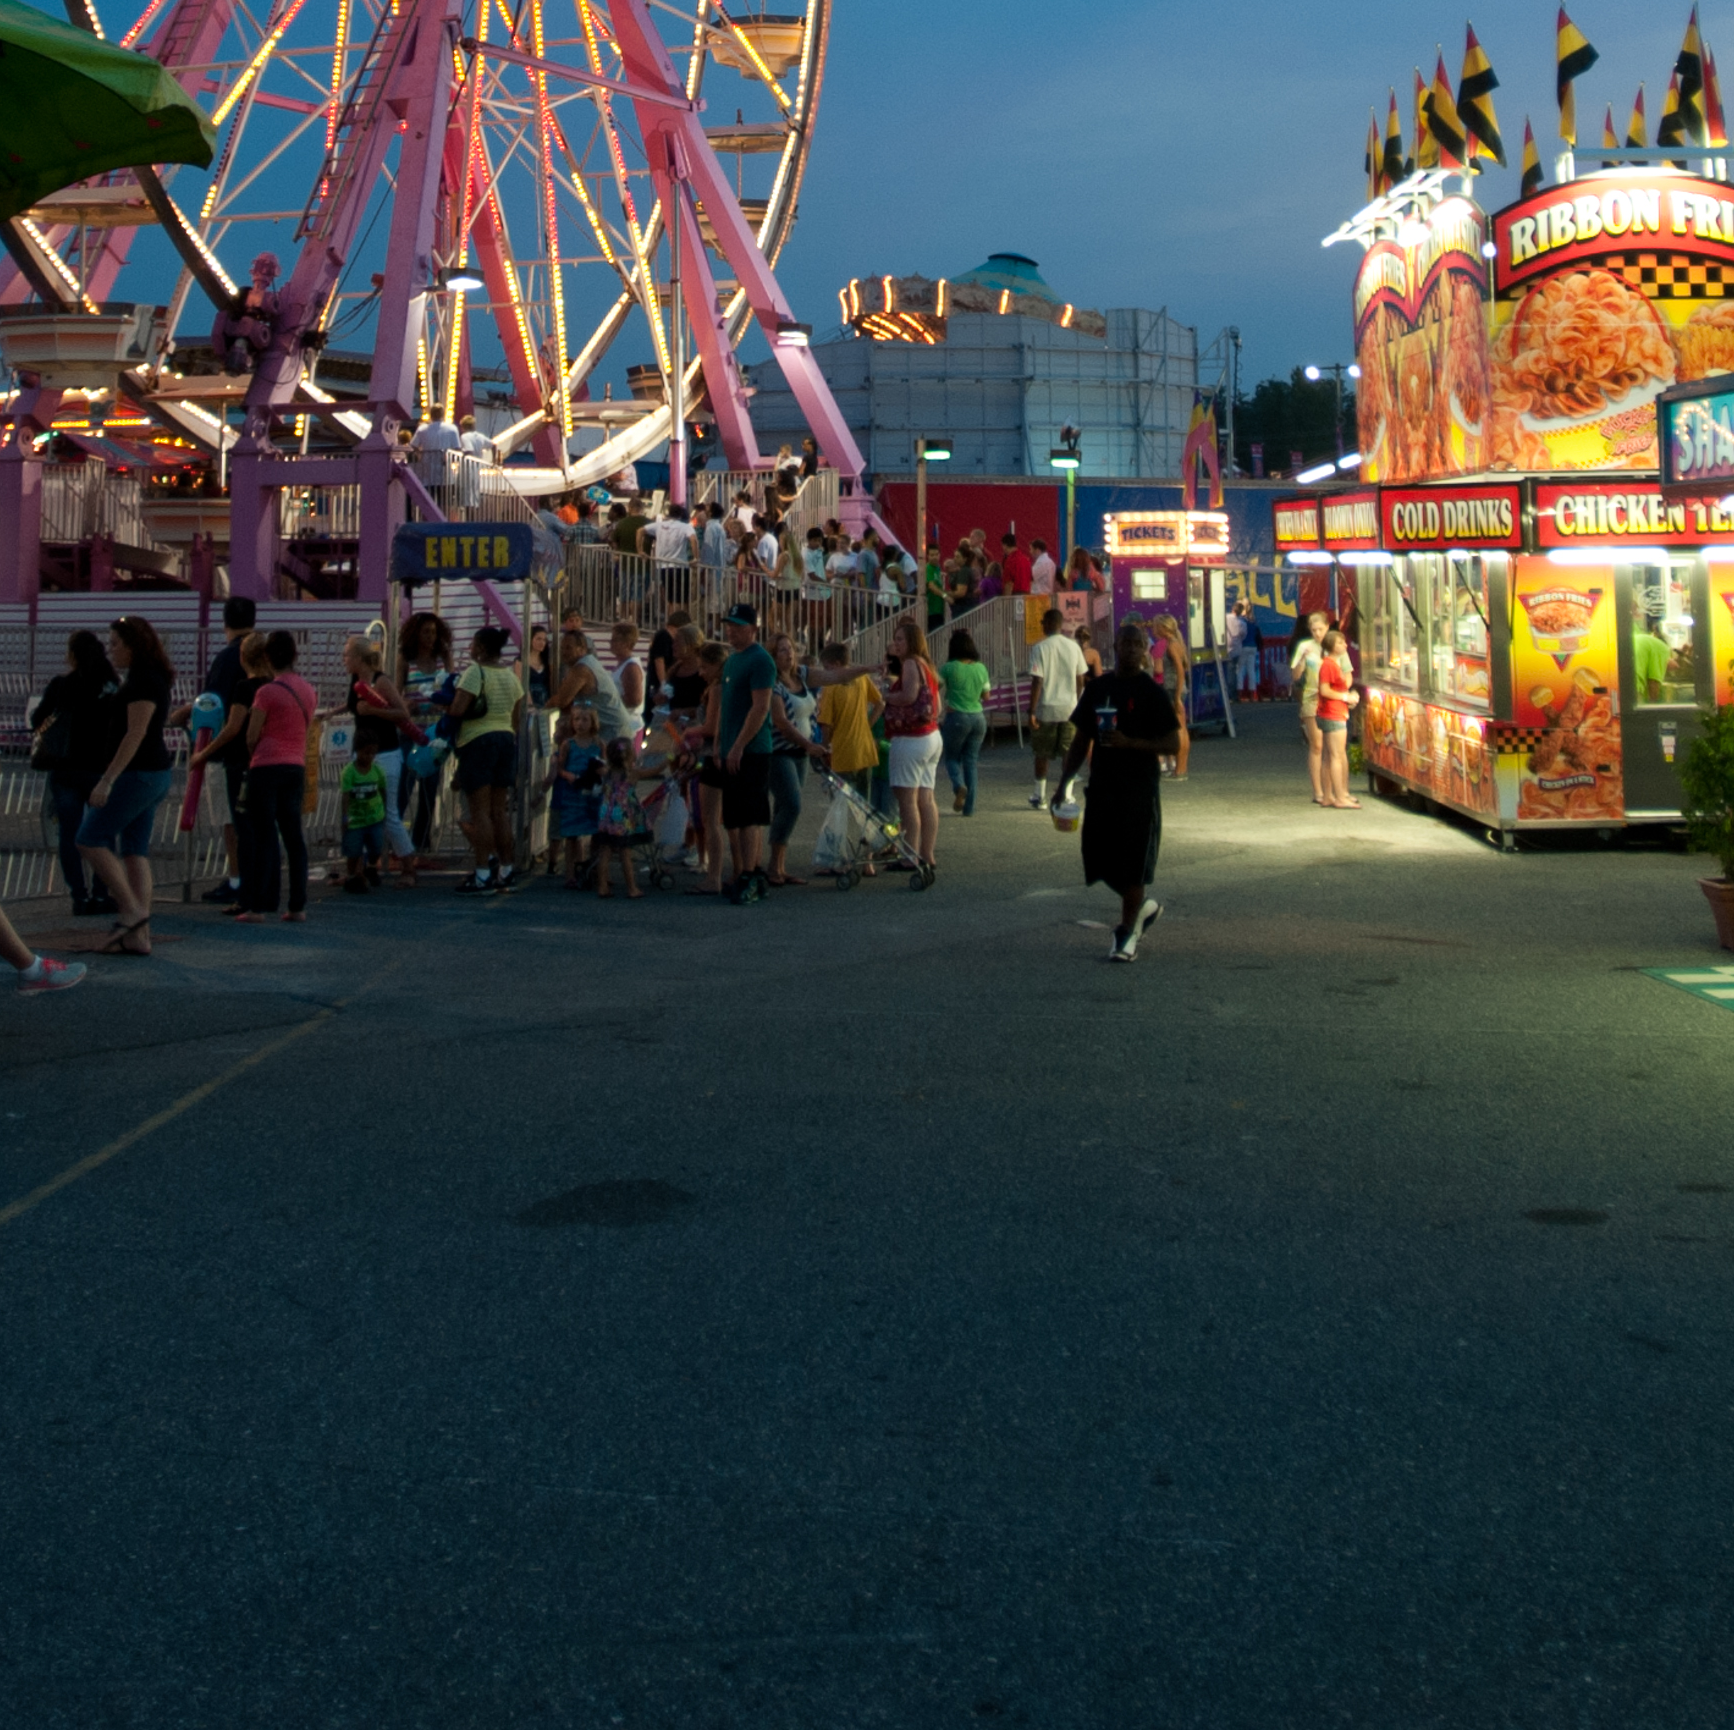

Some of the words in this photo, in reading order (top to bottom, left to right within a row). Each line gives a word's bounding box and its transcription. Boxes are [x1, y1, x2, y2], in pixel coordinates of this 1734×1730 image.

[1510, 189, 1661, 266] RIBBON
[1122, 526, 1175, 541] TICKETS
[1392, 502, 1440, 541] COLD
[1443, 497, 1514, 540] DRINKS
[1555, 493, 1686, 535] CHICKEN
[425, 536, 510, 568] ENTER
